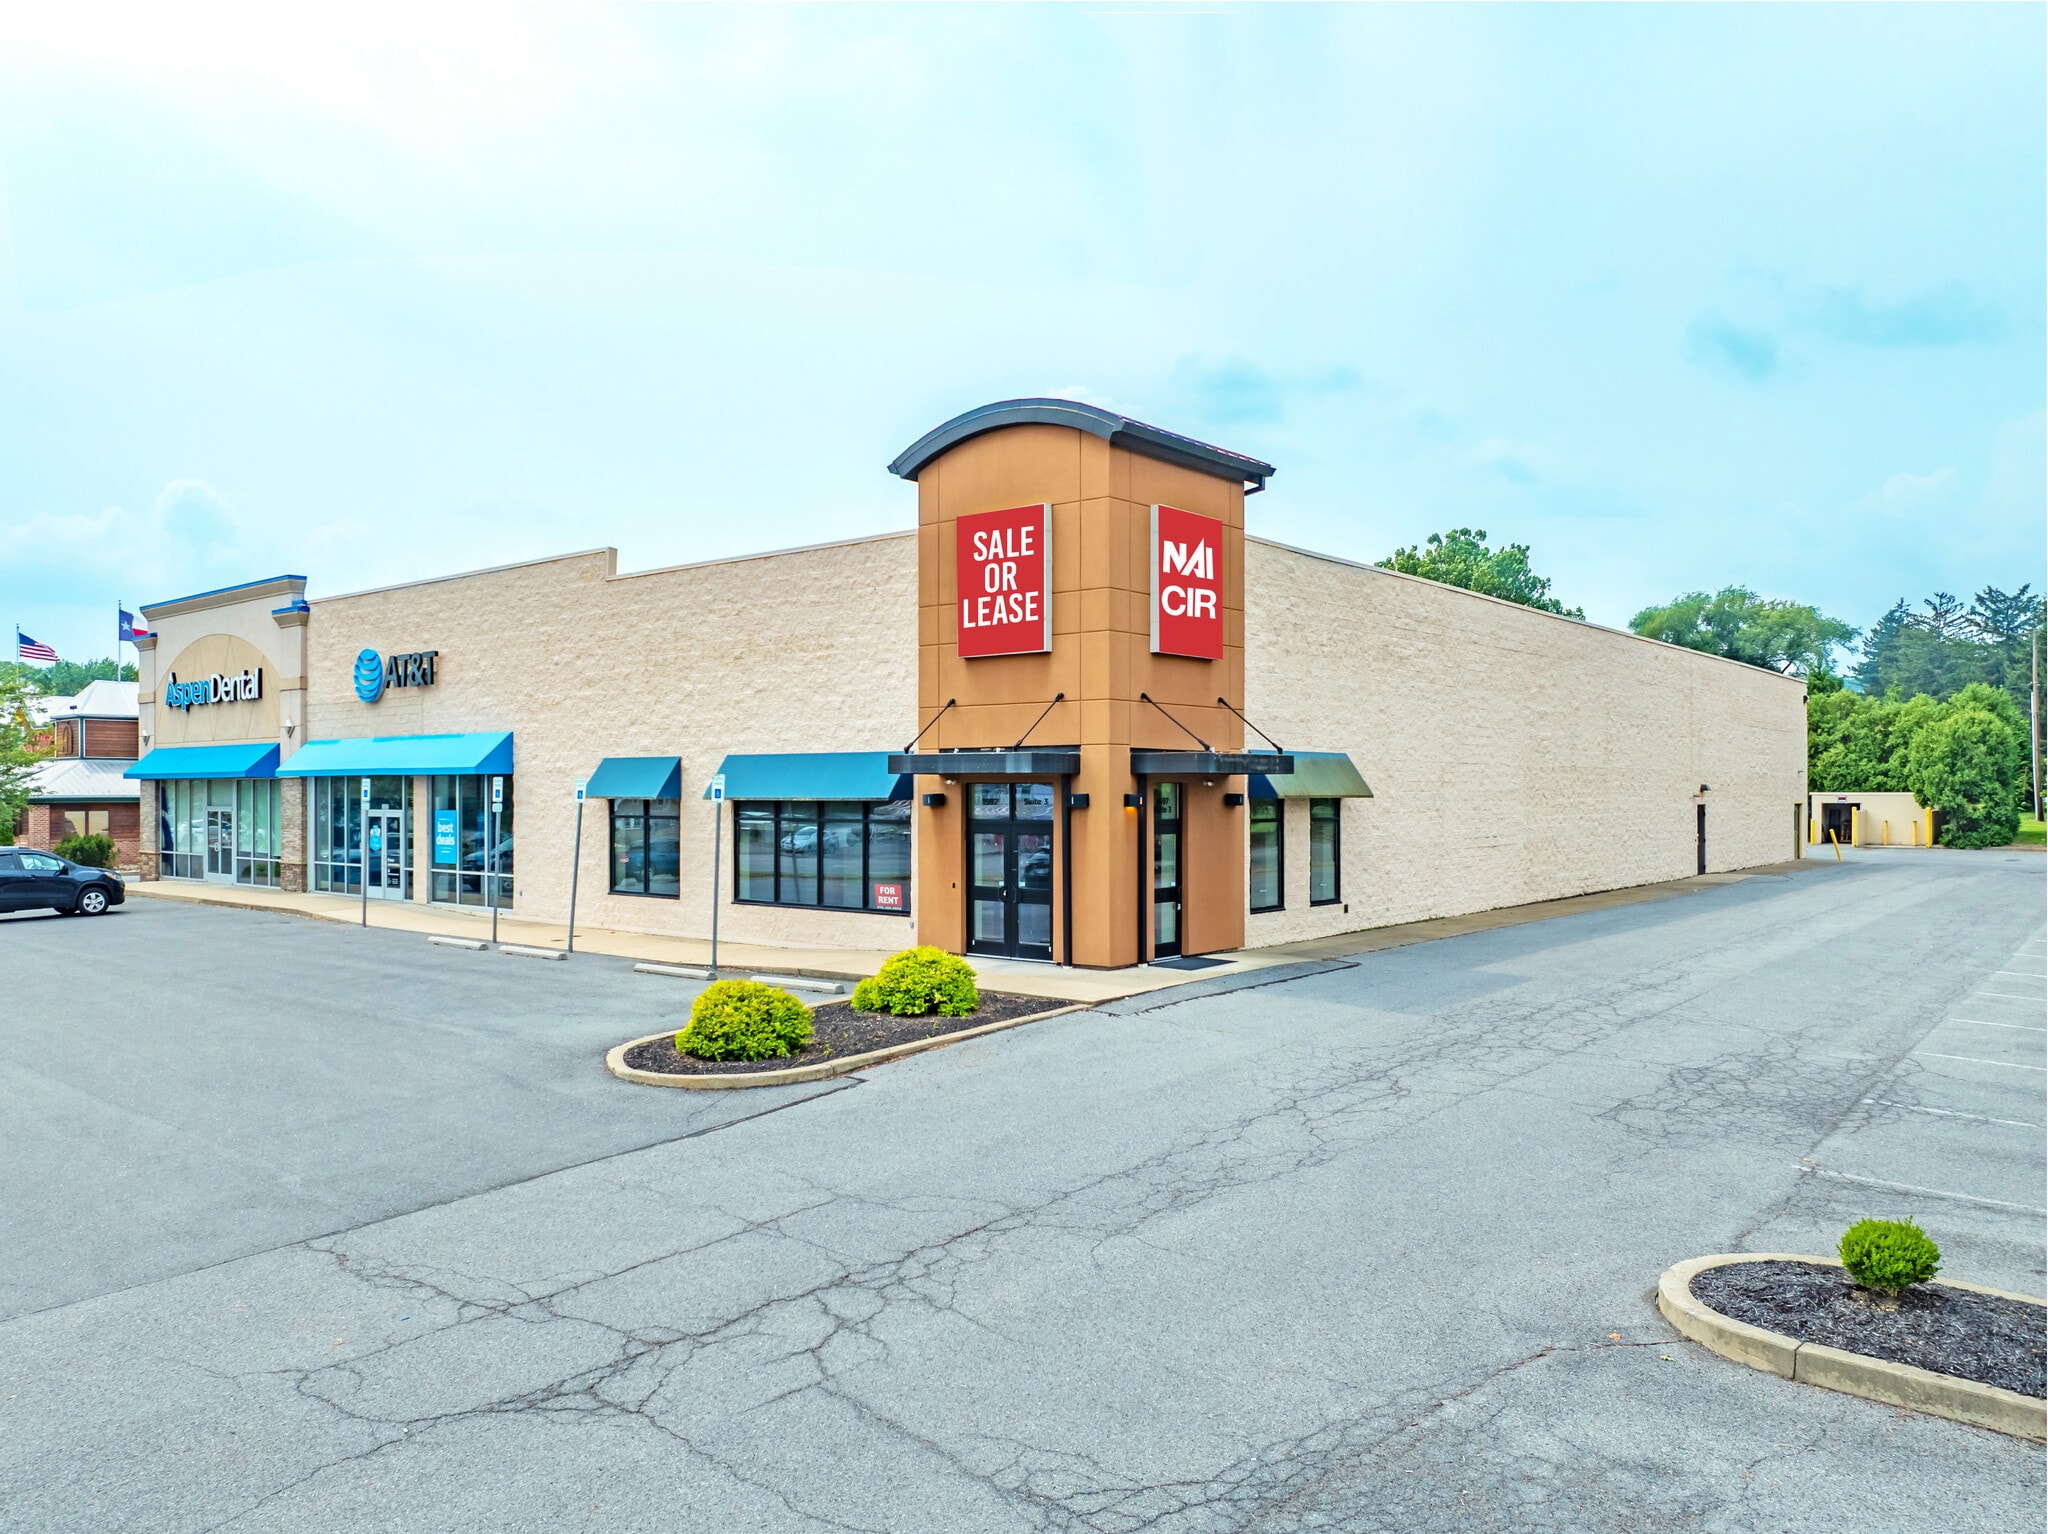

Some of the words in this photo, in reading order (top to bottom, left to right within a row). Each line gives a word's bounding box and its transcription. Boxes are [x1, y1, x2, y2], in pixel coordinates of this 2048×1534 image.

[973, 526, 1034, 562] SALE
[1163, 537, 1214, 580] NAI
[984, 561, 1018, 593] OR
[963, 591, 1039, 628] LEASE
[1161, 585, 1217, 619] CIR
[384, 651, 437, 688] AT&T
[436, 834, 455, 845] deals
[437, 821, 454, 833] best
[878, 896, 899, 905] RENT
[879, 886, 896, 895] FOR
